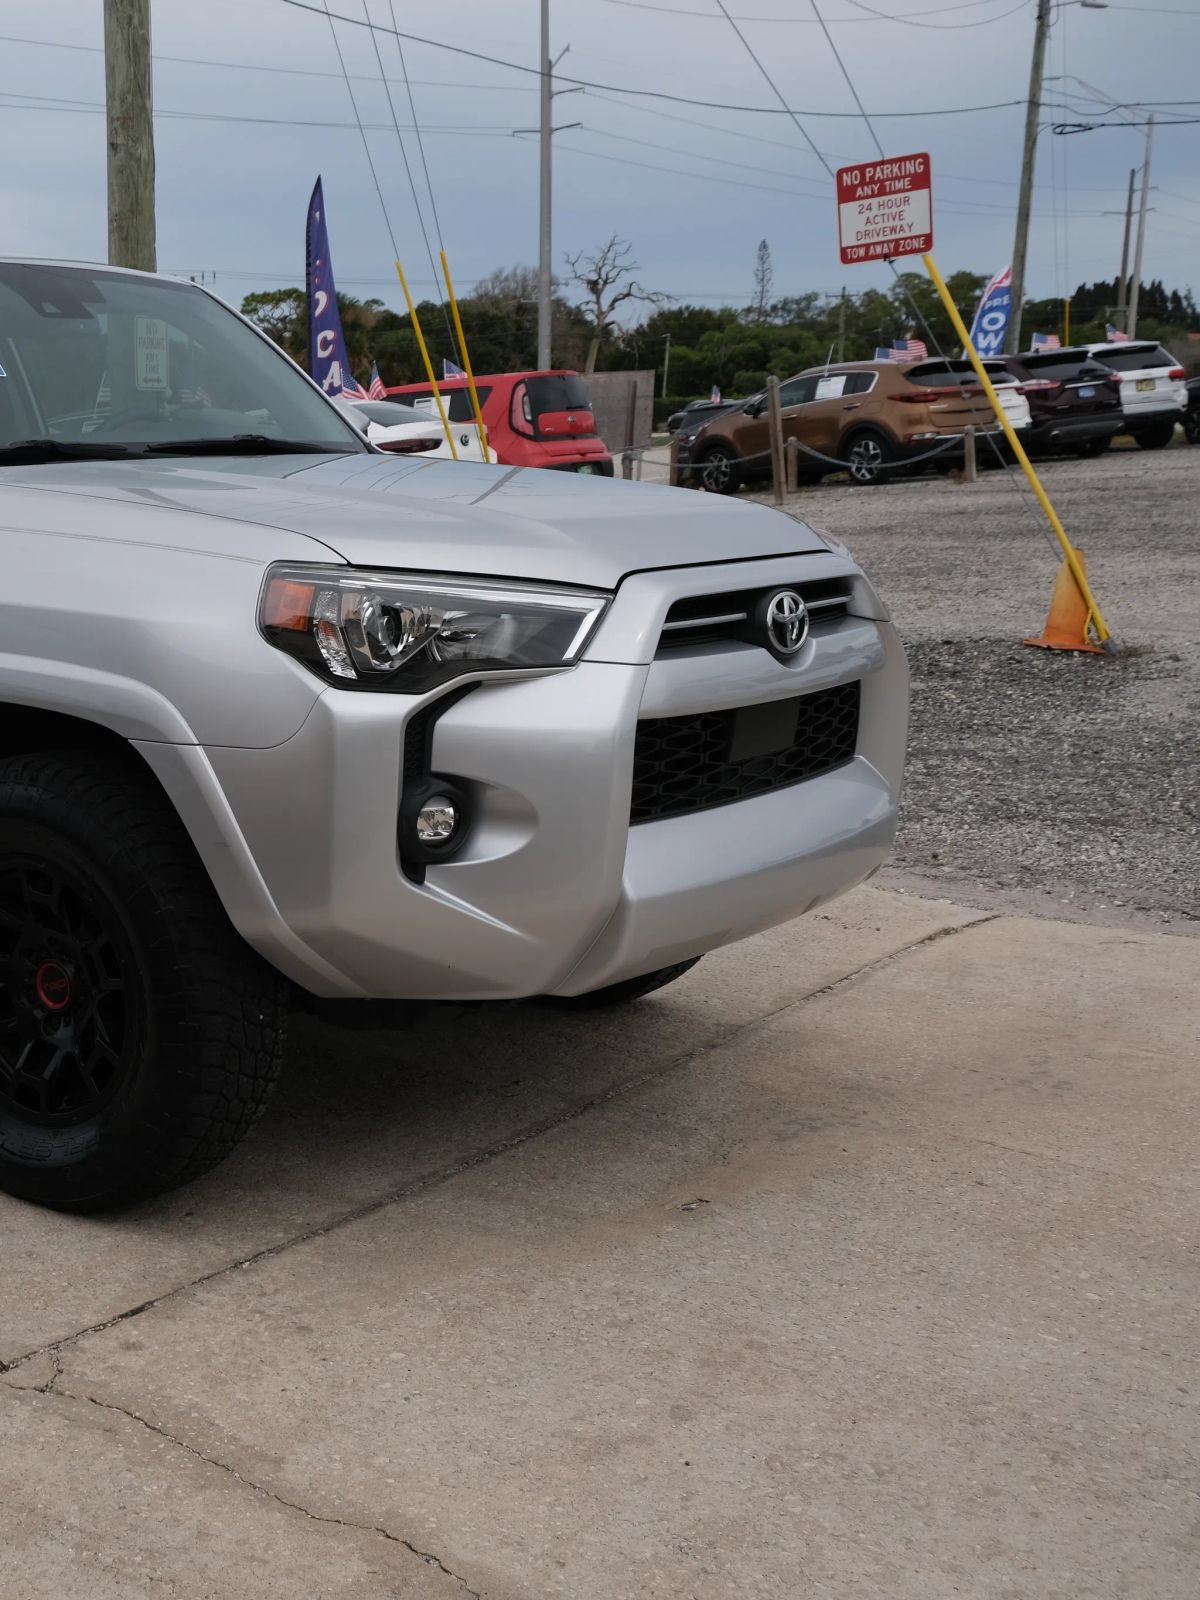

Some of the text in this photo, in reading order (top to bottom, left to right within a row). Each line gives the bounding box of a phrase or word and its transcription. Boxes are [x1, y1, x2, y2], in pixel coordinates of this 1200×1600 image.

[842, 158, 924, 186] NO PARKING
[856, 178, 912, 198] ANY TIME
[858, 196, 911, 215] 24 HOUR
[865, 210, 905, 226] ACTIVE
[856, 222, 914, 241] DRIVEWAY
[846, 237, 926, 259] TOW AWAY ZONE
